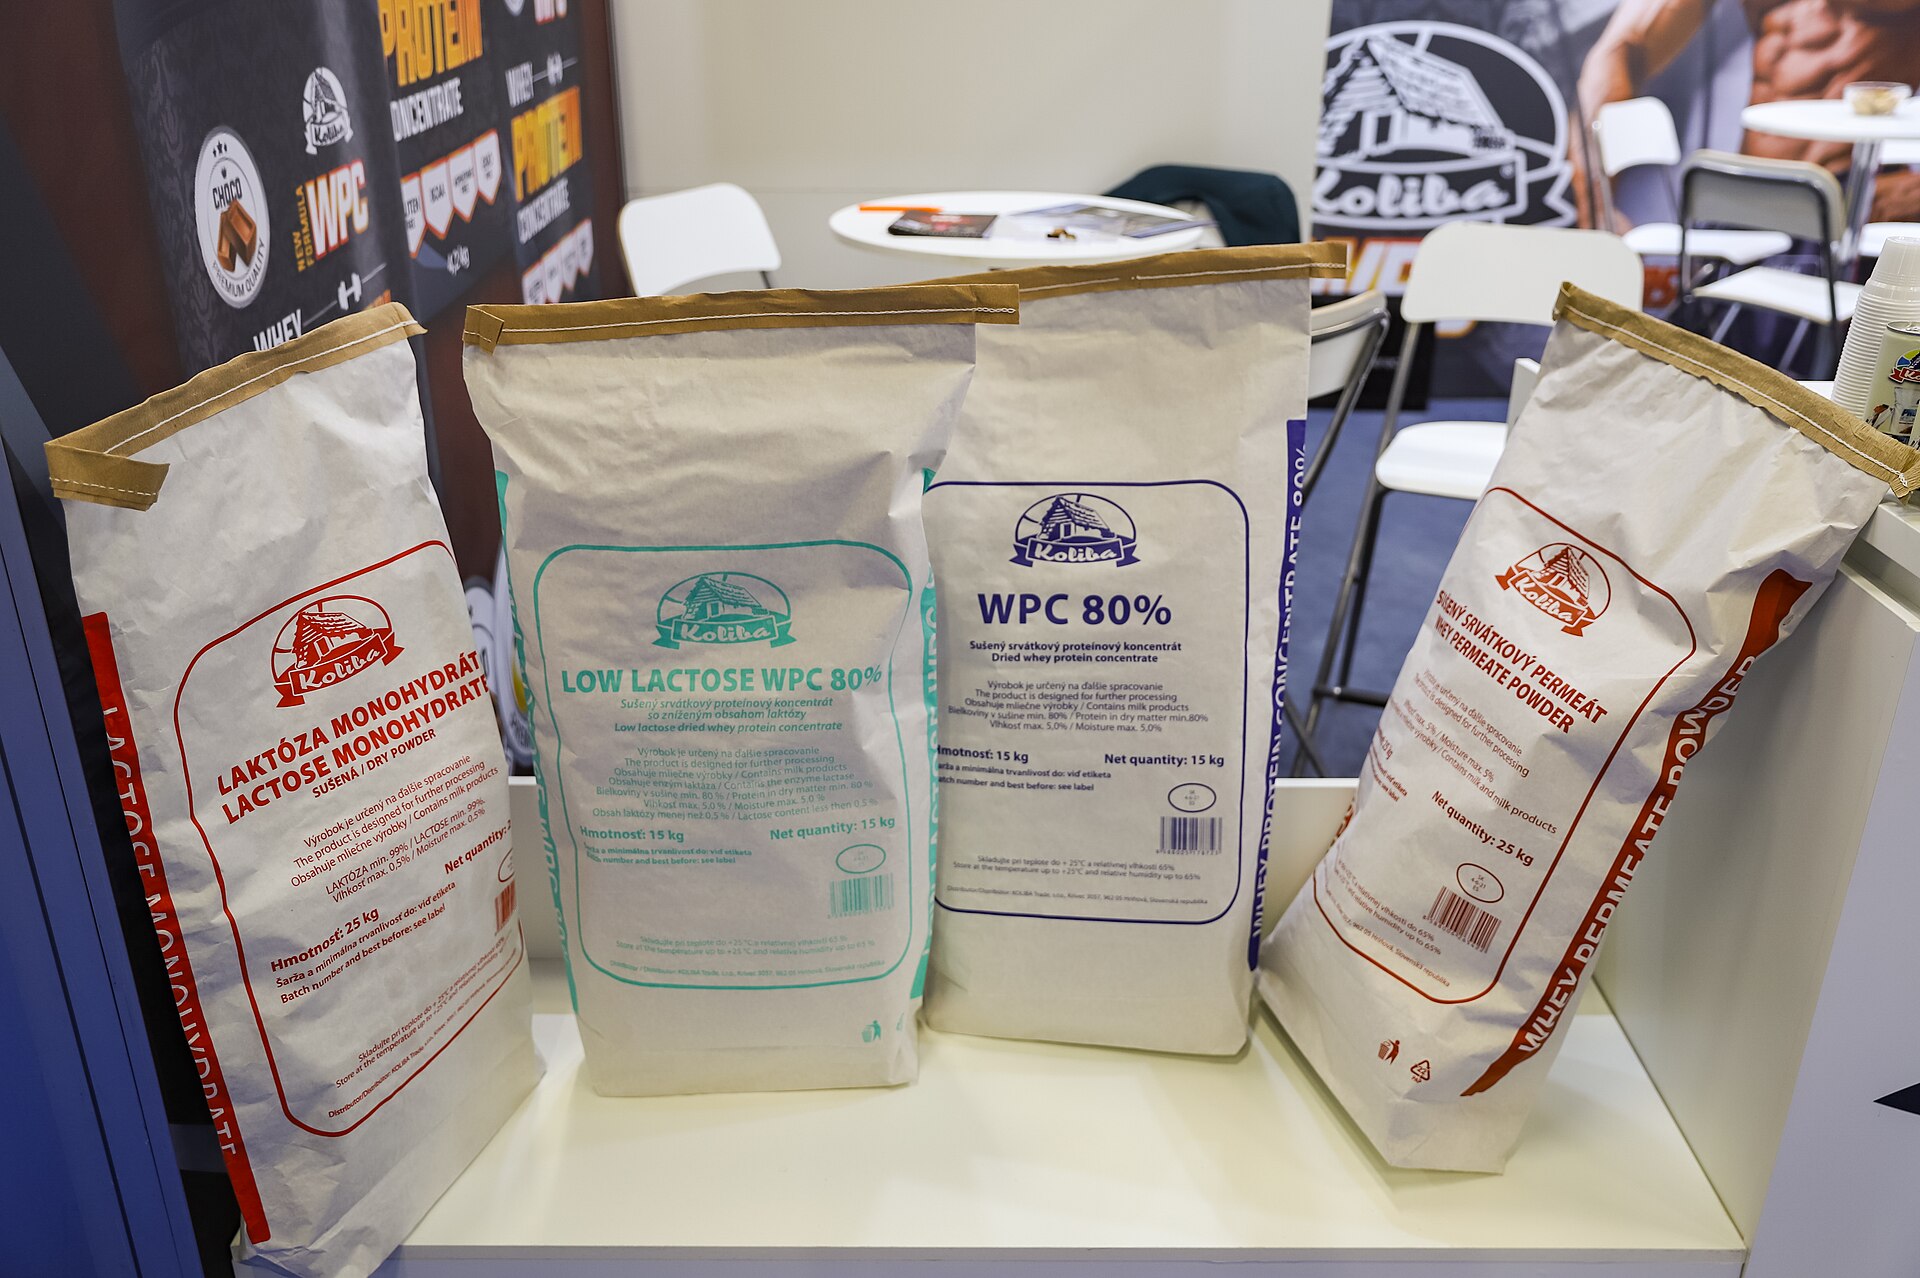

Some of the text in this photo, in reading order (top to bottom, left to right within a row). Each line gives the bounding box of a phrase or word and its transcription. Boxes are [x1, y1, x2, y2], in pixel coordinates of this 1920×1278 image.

[377, 0, 483, 86] PROTEIN
[390, 77, 464, 142] ONCENTRATE
[212, 177, 242, 209] CHOCO
[305, 160, 368, 260] WPC
[293, 185, 315, 271] NEW FORMULA
[212, 238, 264, 297] PREMIUM QUALITY
[1034, 543, 1117, 562] Koliba
[977, 593, 1171, 625] WPC 80%
[1515, 577, 1573, 622] Koliba
[680, 623, 771, 643] Koliba
[970, 641, 1181, 652] Sušený srvátkový proteínový koncentrát
[300, 648, 380, 691] Koliba
[562, 665, 881, 692] LOW LACTOSE WPC 80%
[992, 653, 1158, 663] Dried whey protein concentrate
[1461, 614, 1536, 671] SRVÁTKOVÝ
[1530, 664, 1607, 723] PERMEÁT
[620, 698, 657, 711] Sušený
[660, 698, 712, 710] srvátkový
[774, 697, 832, 708] koncentrát
[975, 688, 990, 697] The
[992, 691, 1026, 700] product
[1038, 692, 1078, 702] designed
[1081, 692, 1093, 700] for
[1095, 692, 1126, 700] further
[1129, 693, 1177, 702] processing
[987, 680, 1023, 690] Výrobok
[1025, 683, 1034, 691] je
[1109, 683, 1163, 692] spracovanie
[1450, 631, 1511, 684] PERMEATE
[1506, 676, 1573, 733] POWDER
[218, 727, 329, 795] LAKTÓZA
[331, 651, 479, 738] MONOHYDRÁT
[648, 712, 659, 720] so
[714, 709, 764, 718] obsahom
[964, 698, 1004, 710] Obsahuje
[1043, 702, 1078, 712] výrobky
[1086, 702, 1125, 710] Contains
[1127, 702, 1146, 710] milk
[1149, 703, 1189, 712] products
[222, 755, 331, 823] LACTOSE
[332, 674, 488, 768] MONOHYDRATE
[614, 722, 842, 734] Low lactose dried whey protein concentrate
[1486, 723, 1522, 756] spracovanie
[312, 766, 359, 797] SUŠENÁ
[366, 752, 388, 770] DRY
[390, 729, 436, 758] POWDER
[997, 751, 1010, 760] 15
[1014, 751, 1028, 764] kg
[1105, 754, 1224, 767] Net quantity: 15 kg
[1492, 745, 1529, 778] processing
[293, 761, 485, 868] The product is designed for further processing
[303, 756, 470, 847] Výrobok je určený na ďalšie spracovanie
[1466, 773, 1481, 787] milk
[1479, 784, 1495, 798] and
[1493, 795, 1510, 811] milk
[1510, 807, 1556, 833] products
[291, 859, 336, 886] Obsahuje
[336, 839, 372, 862] mliečne
[372, 819, 406, 842] výrobky
[413, 796, 448, 820] Contains
[448, 785, 465, 800] milk
[466, 767, 498, 792] products
[580, 826, 684, 843] Hmotnosť: 15 kg
[770, 816, 894, 839] Net quantity: 15 kg
[1432, 790, 1533, 866] Net quantity: 25 kg
[444, 827, 506, 874] Net quantity:
[271, 909, 378, 972] Hmotnosť: 25 kg
[276, 973, 305, 987] Šarža
[315, 941, 357, 973] minimálna
[358, 912, 402, 943] trvanlivosť
[400, 906, 417, 917] do:
[418, 896, 431, 909] viď
[430, 882, 455, 901] etiketa
[280, 903, 445, 1003] Batch number and best before: see label
